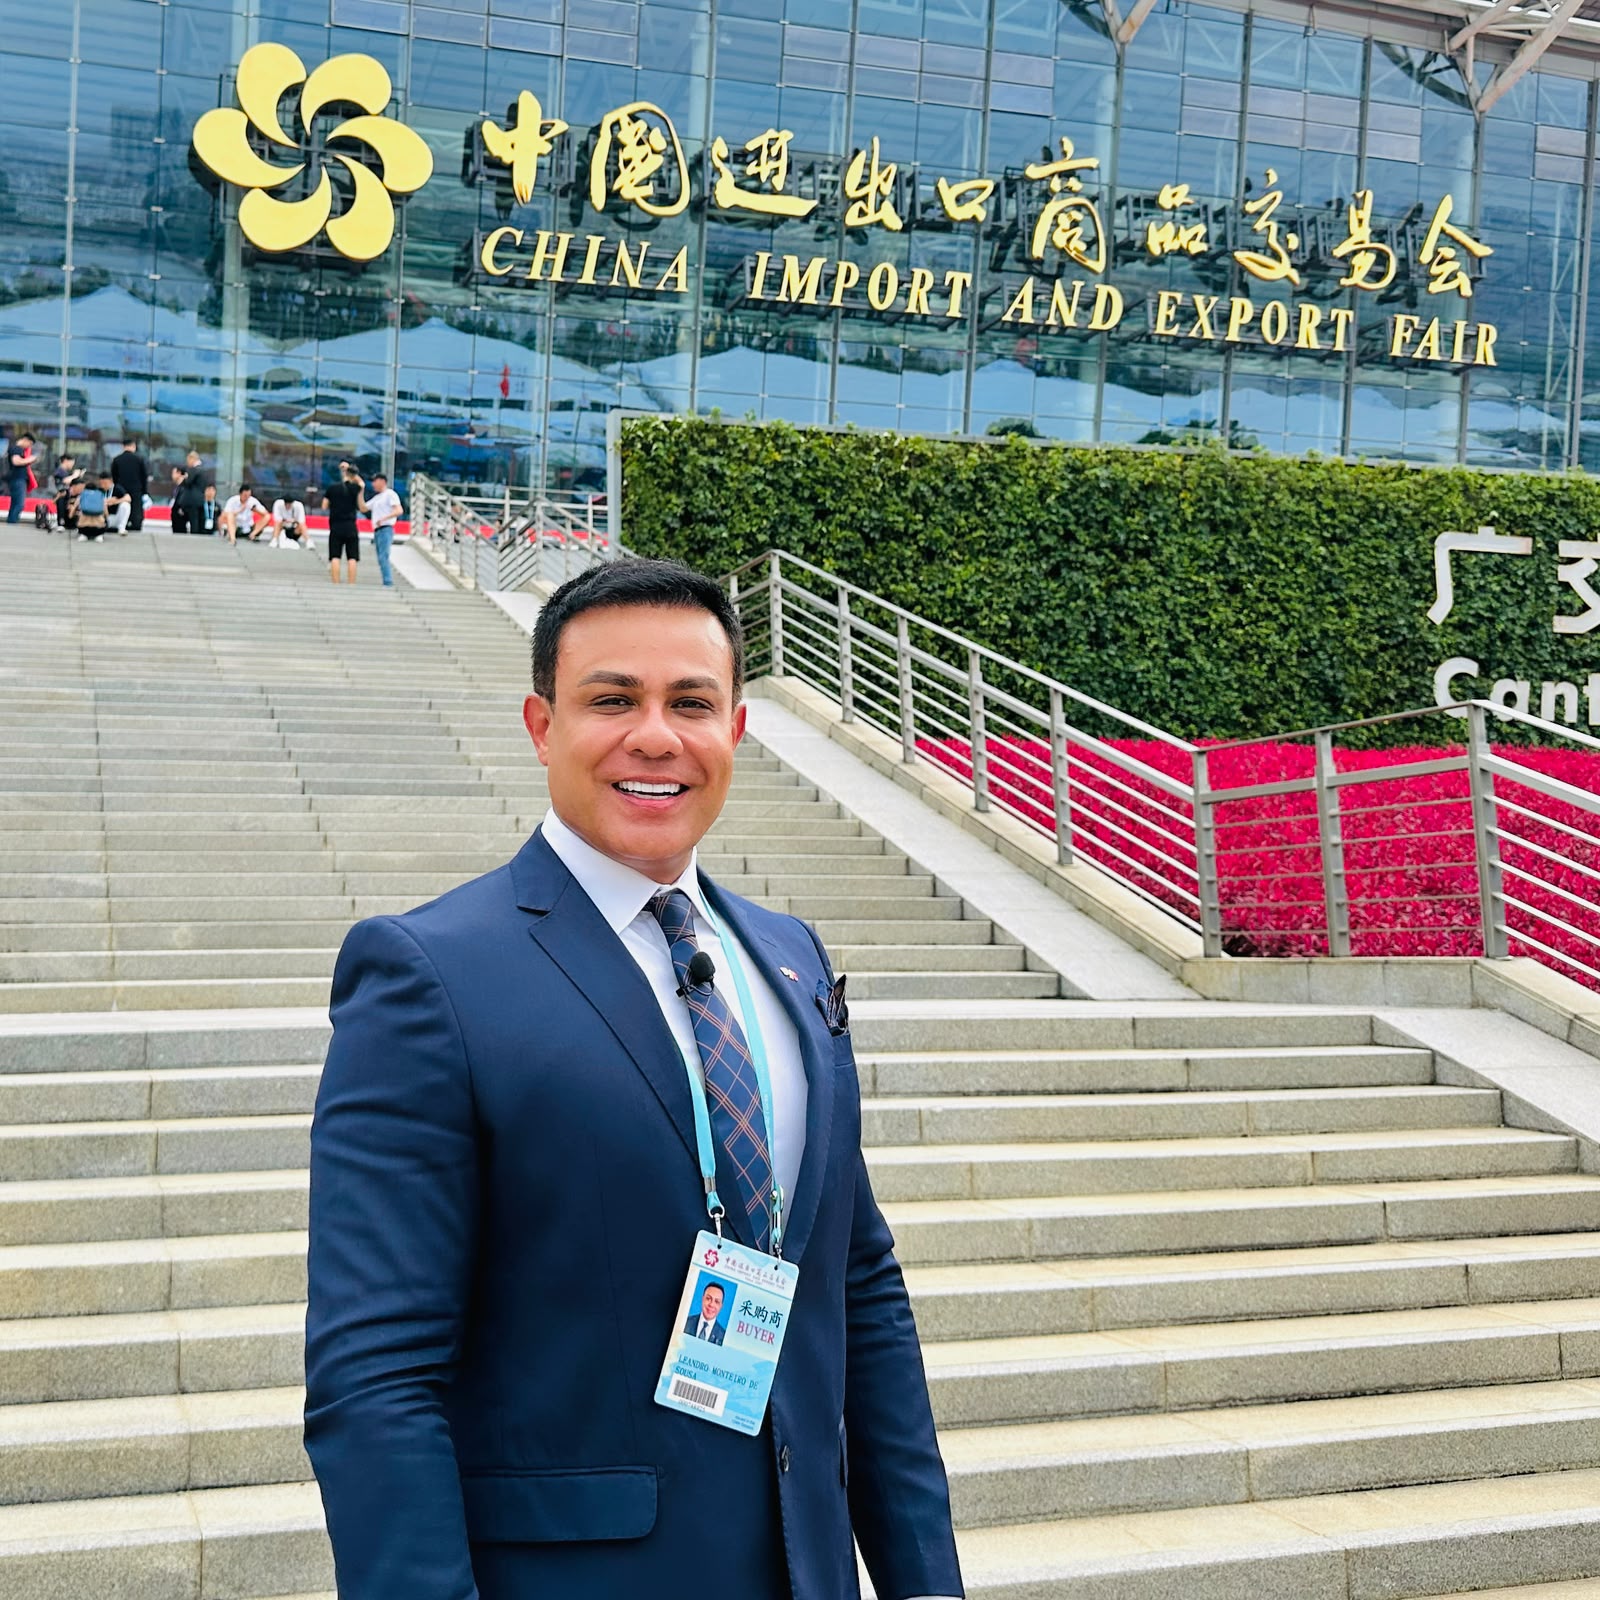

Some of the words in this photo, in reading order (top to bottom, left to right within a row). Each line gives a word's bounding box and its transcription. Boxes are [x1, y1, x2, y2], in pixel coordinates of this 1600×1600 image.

[479, 226, 689, 293] CHINA
[748, 252, 973, 318] IMPORT
[1002, 276, 1124, 331] AND
[1154, 290, 1355, 353] EXPORT
[1389, 314, 1499, 367] FAIR
[738, 1299, 784, 1328] 采购商
[736, 1320, 775, 1345] BUYER
[674, 1365, 697, 1380] SOUSA
[678, 1354, 709, 1372] LEANDRO
[712, 1367, 747, 1386] MONTEIRO
[749, 1380, 759, 1390] DE
